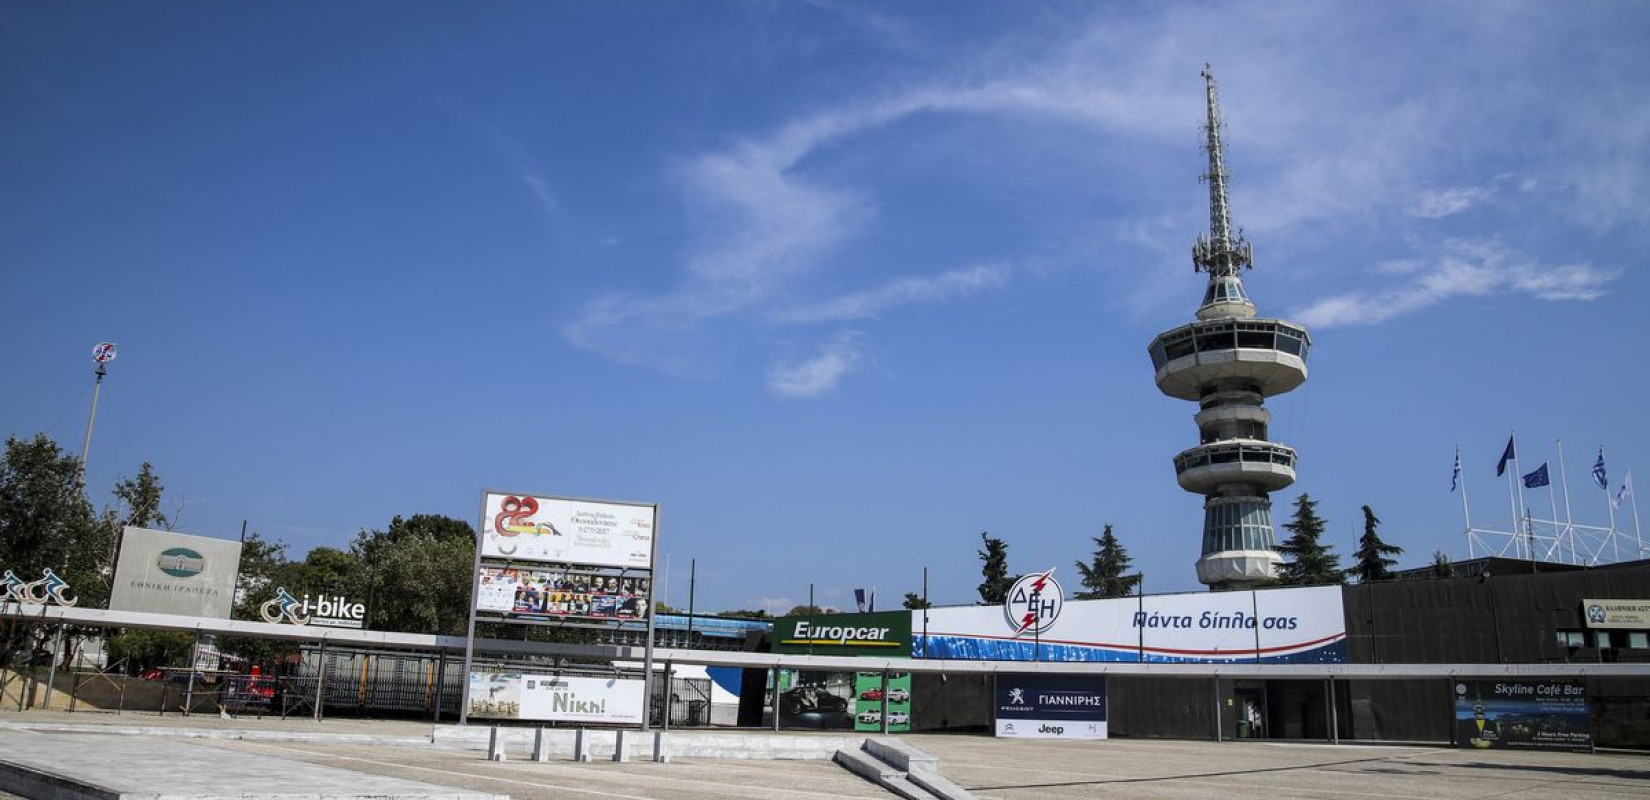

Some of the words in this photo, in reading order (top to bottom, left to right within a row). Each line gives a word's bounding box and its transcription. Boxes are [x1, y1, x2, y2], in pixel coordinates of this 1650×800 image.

[130, 580, 170, 592] ΕΘΝΙΚΗ
[303, 594, 366, 619] i-bike
[1011, 587, 1056, 619] ΔΕΗ
[1132, 610, 1193, 629] Πάντα
[1198, 611, 1258, 629] δίπλα
[1262, 616, 1298, 630] σας
[793, 621, 890, 645] Europcar
[1495, 683, 1534, 696] Skyline
[1536, 683, 1561, 696] Café
[1564, 685, 1585, 695] Bar
[1038, 694, 1101, 706] ΓΙΑΝΝΙΡΗΣ
[1038, 724, 1065, 735] Jeep
